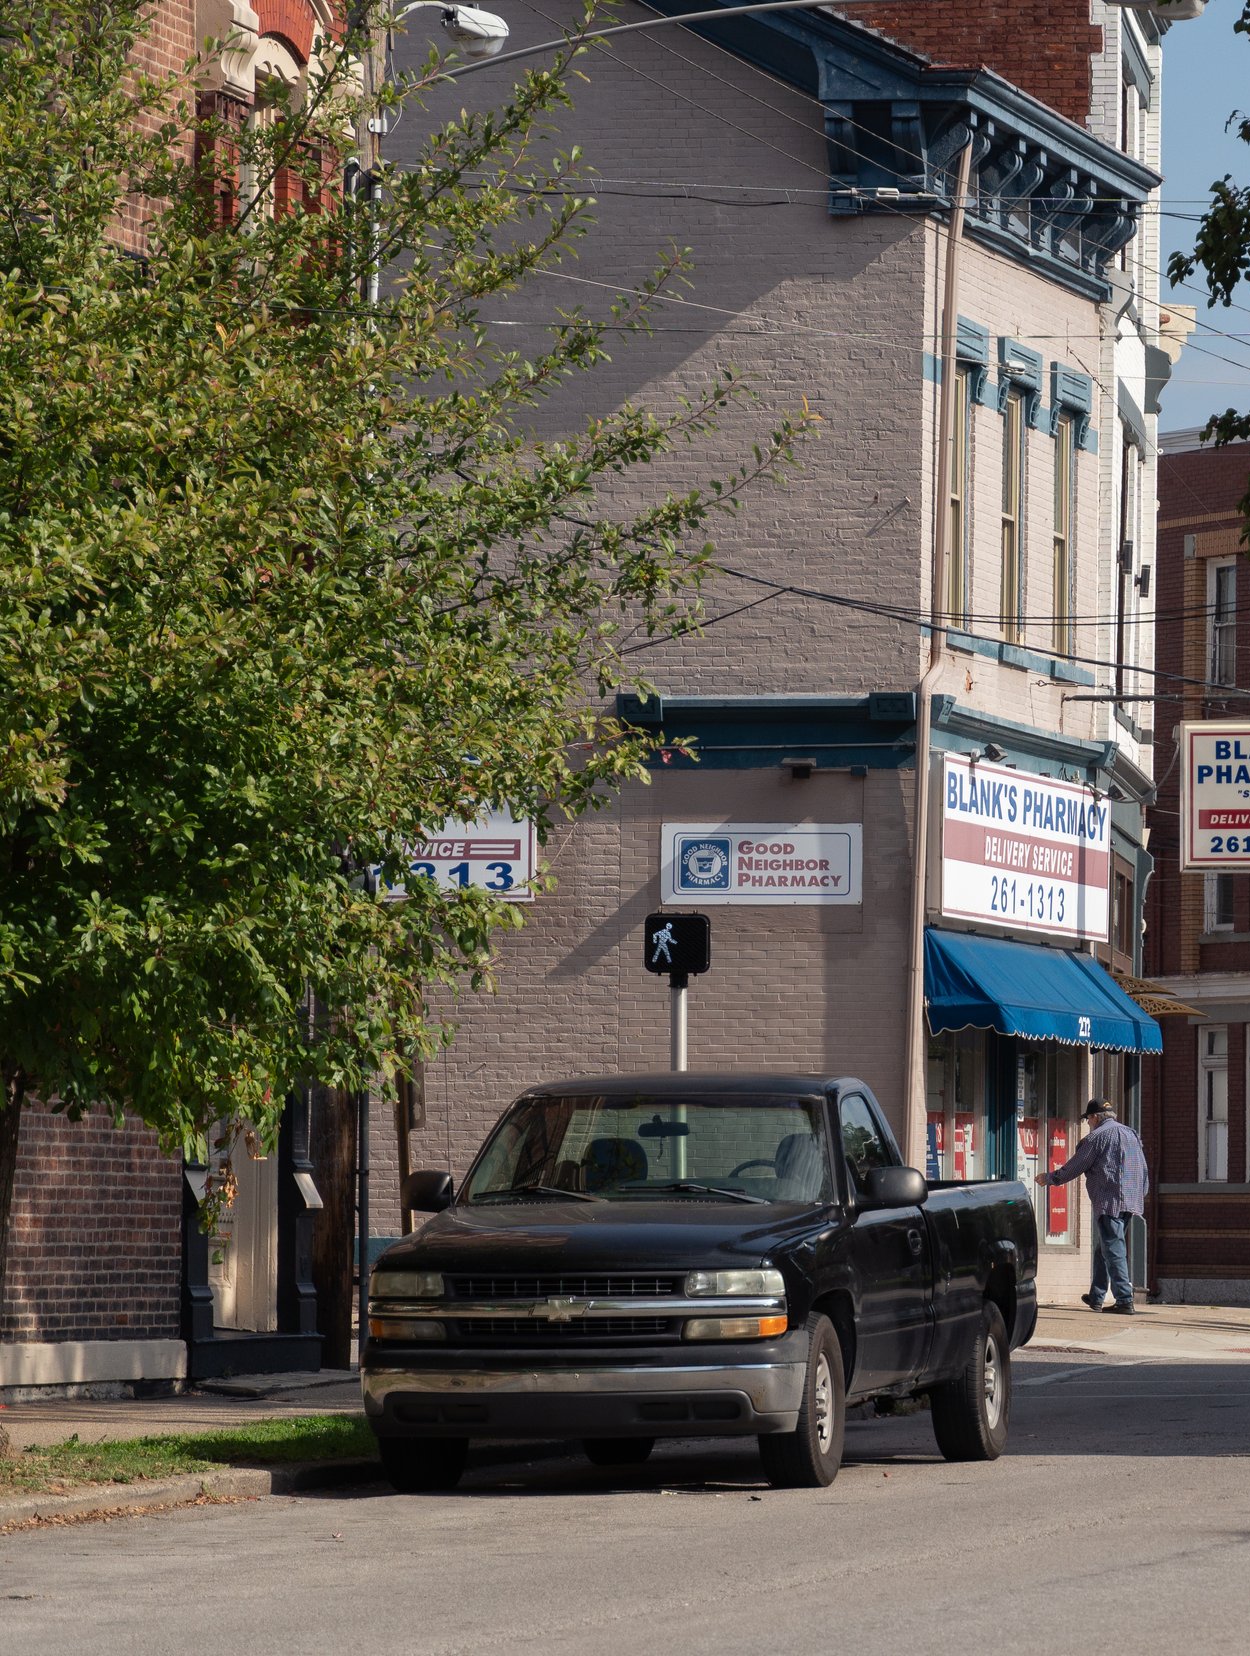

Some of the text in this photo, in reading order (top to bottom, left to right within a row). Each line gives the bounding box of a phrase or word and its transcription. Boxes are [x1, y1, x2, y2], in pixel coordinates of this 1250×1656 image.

[947, 771, 1107, 842] BLANK'S PHARMACY
[682, 843, 728, 866] GOOD NEIGHBOR
[984, 834, 1073, 877] DELIVERY SERVICE
[685, 871, 724, 885] PHARMACY
[990, 875, 1066, 922] 261-1313
